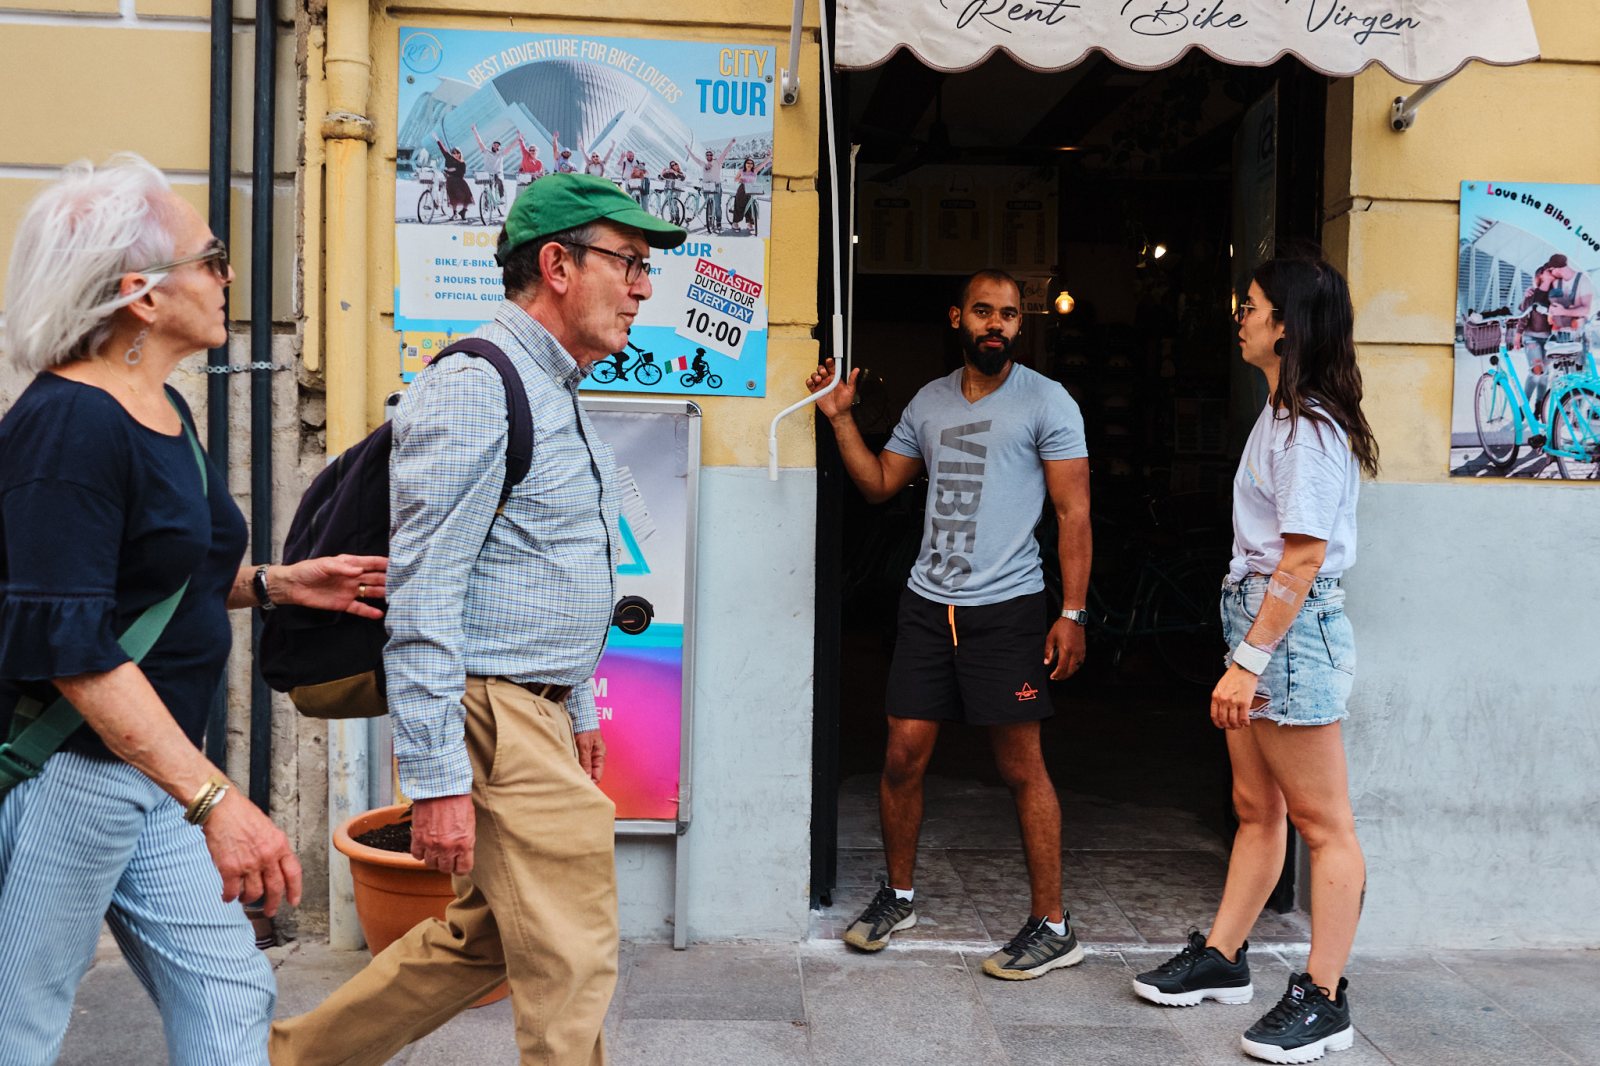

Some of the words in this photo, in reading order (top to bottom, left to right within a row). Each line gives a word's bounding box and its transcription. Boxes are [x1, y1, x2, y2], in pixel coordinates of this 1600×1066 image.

[940, 0, 1081, 34] Rent
[1121, 0, 1248, 36] Bike
[1286, 0, 1421, 45] Virgen
[467, 54, 501, 87] BEST
[500, 38, 579, 69] ADVENTURE
[580, 40, 607, 63] FOR
[606, 48, 640, 74] BIKE
[635, 62, 684, 105] LOVERS
[719, 48, 769, 78] CITY
[695, 79, 767, 117] TOUR
[1486, 183, 1518, 201] Love
[1520, 193, 1542, 210] the
[1574, 225, 1600, 252] Love
[435, 275, 441, 284] 3
[443, 276, 477, 285] HOURS
[435, 291, 478, 301] OFFICIAL
[480, 293, 504, 302] GUID
[694, 274, 728, 297] DUTCH
[729, 288, 755, 309] TOUR
[697, 262, 761, 298] FANTASTIC
[689, 288, 728, 312] EVERY
[727, 306, 753, 322] DAY
[686, 308, 742, 348] 10:00
[927, 419, 993, 588] VIBES
